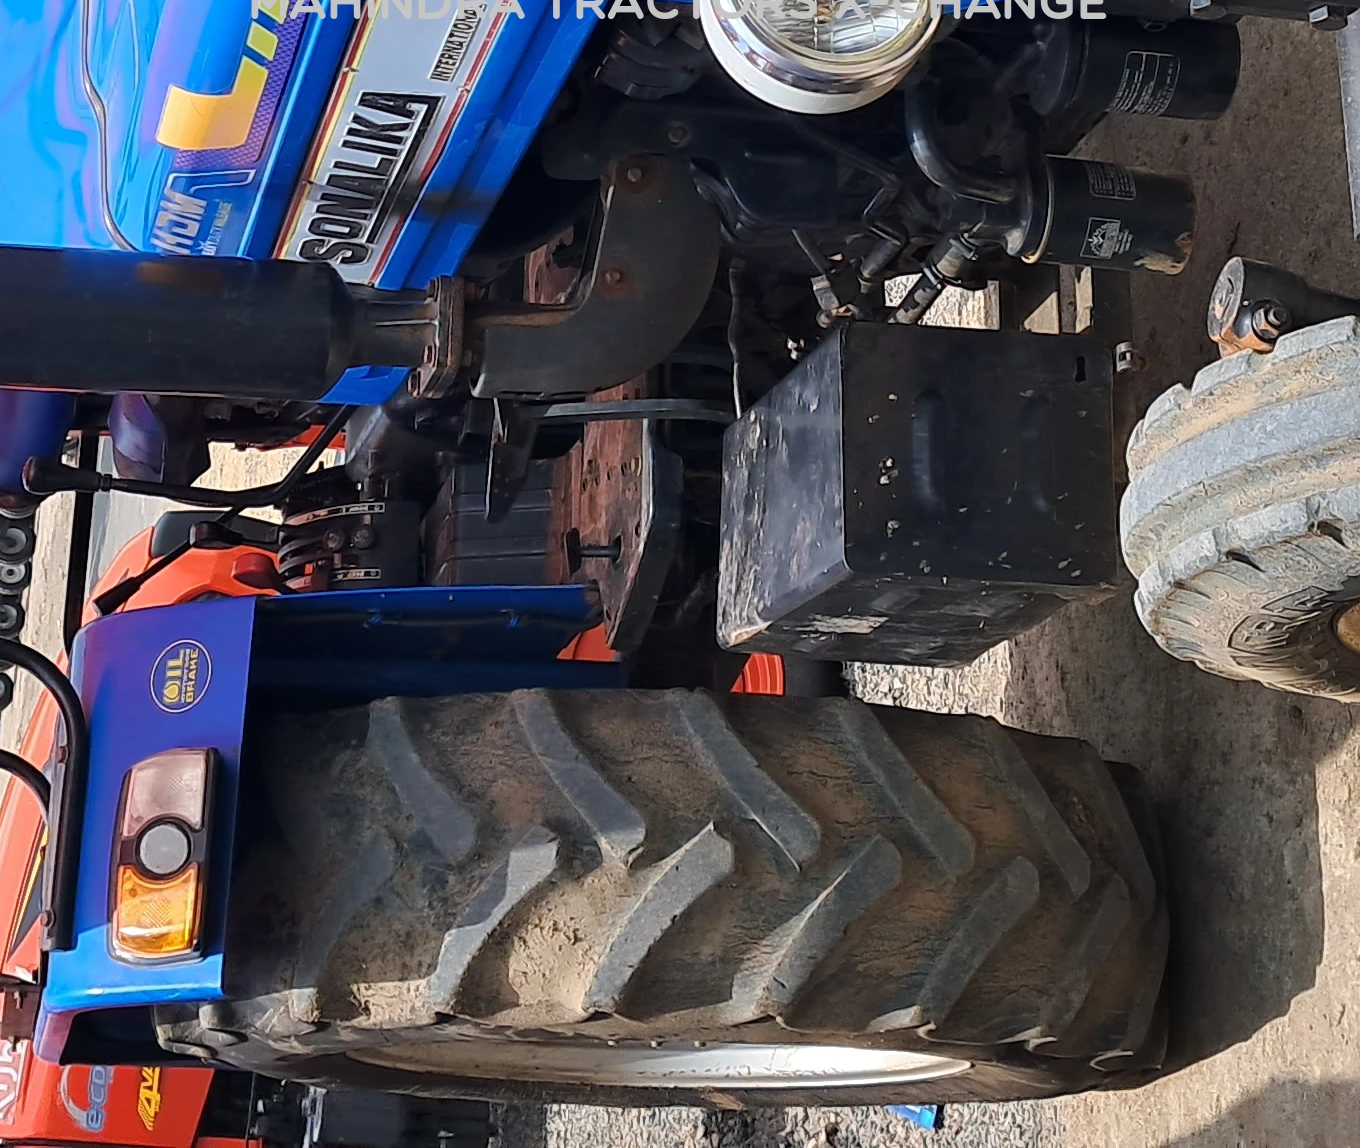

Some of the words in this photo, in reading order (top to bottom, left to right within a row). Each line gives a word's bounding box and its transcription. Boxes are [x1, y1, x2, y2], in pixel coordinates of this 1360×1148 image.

[295, 89, 446, 266] SONALIKA
[162, 649, 184, 703] OIL
[185, 648, 199, 703] BRAKE
